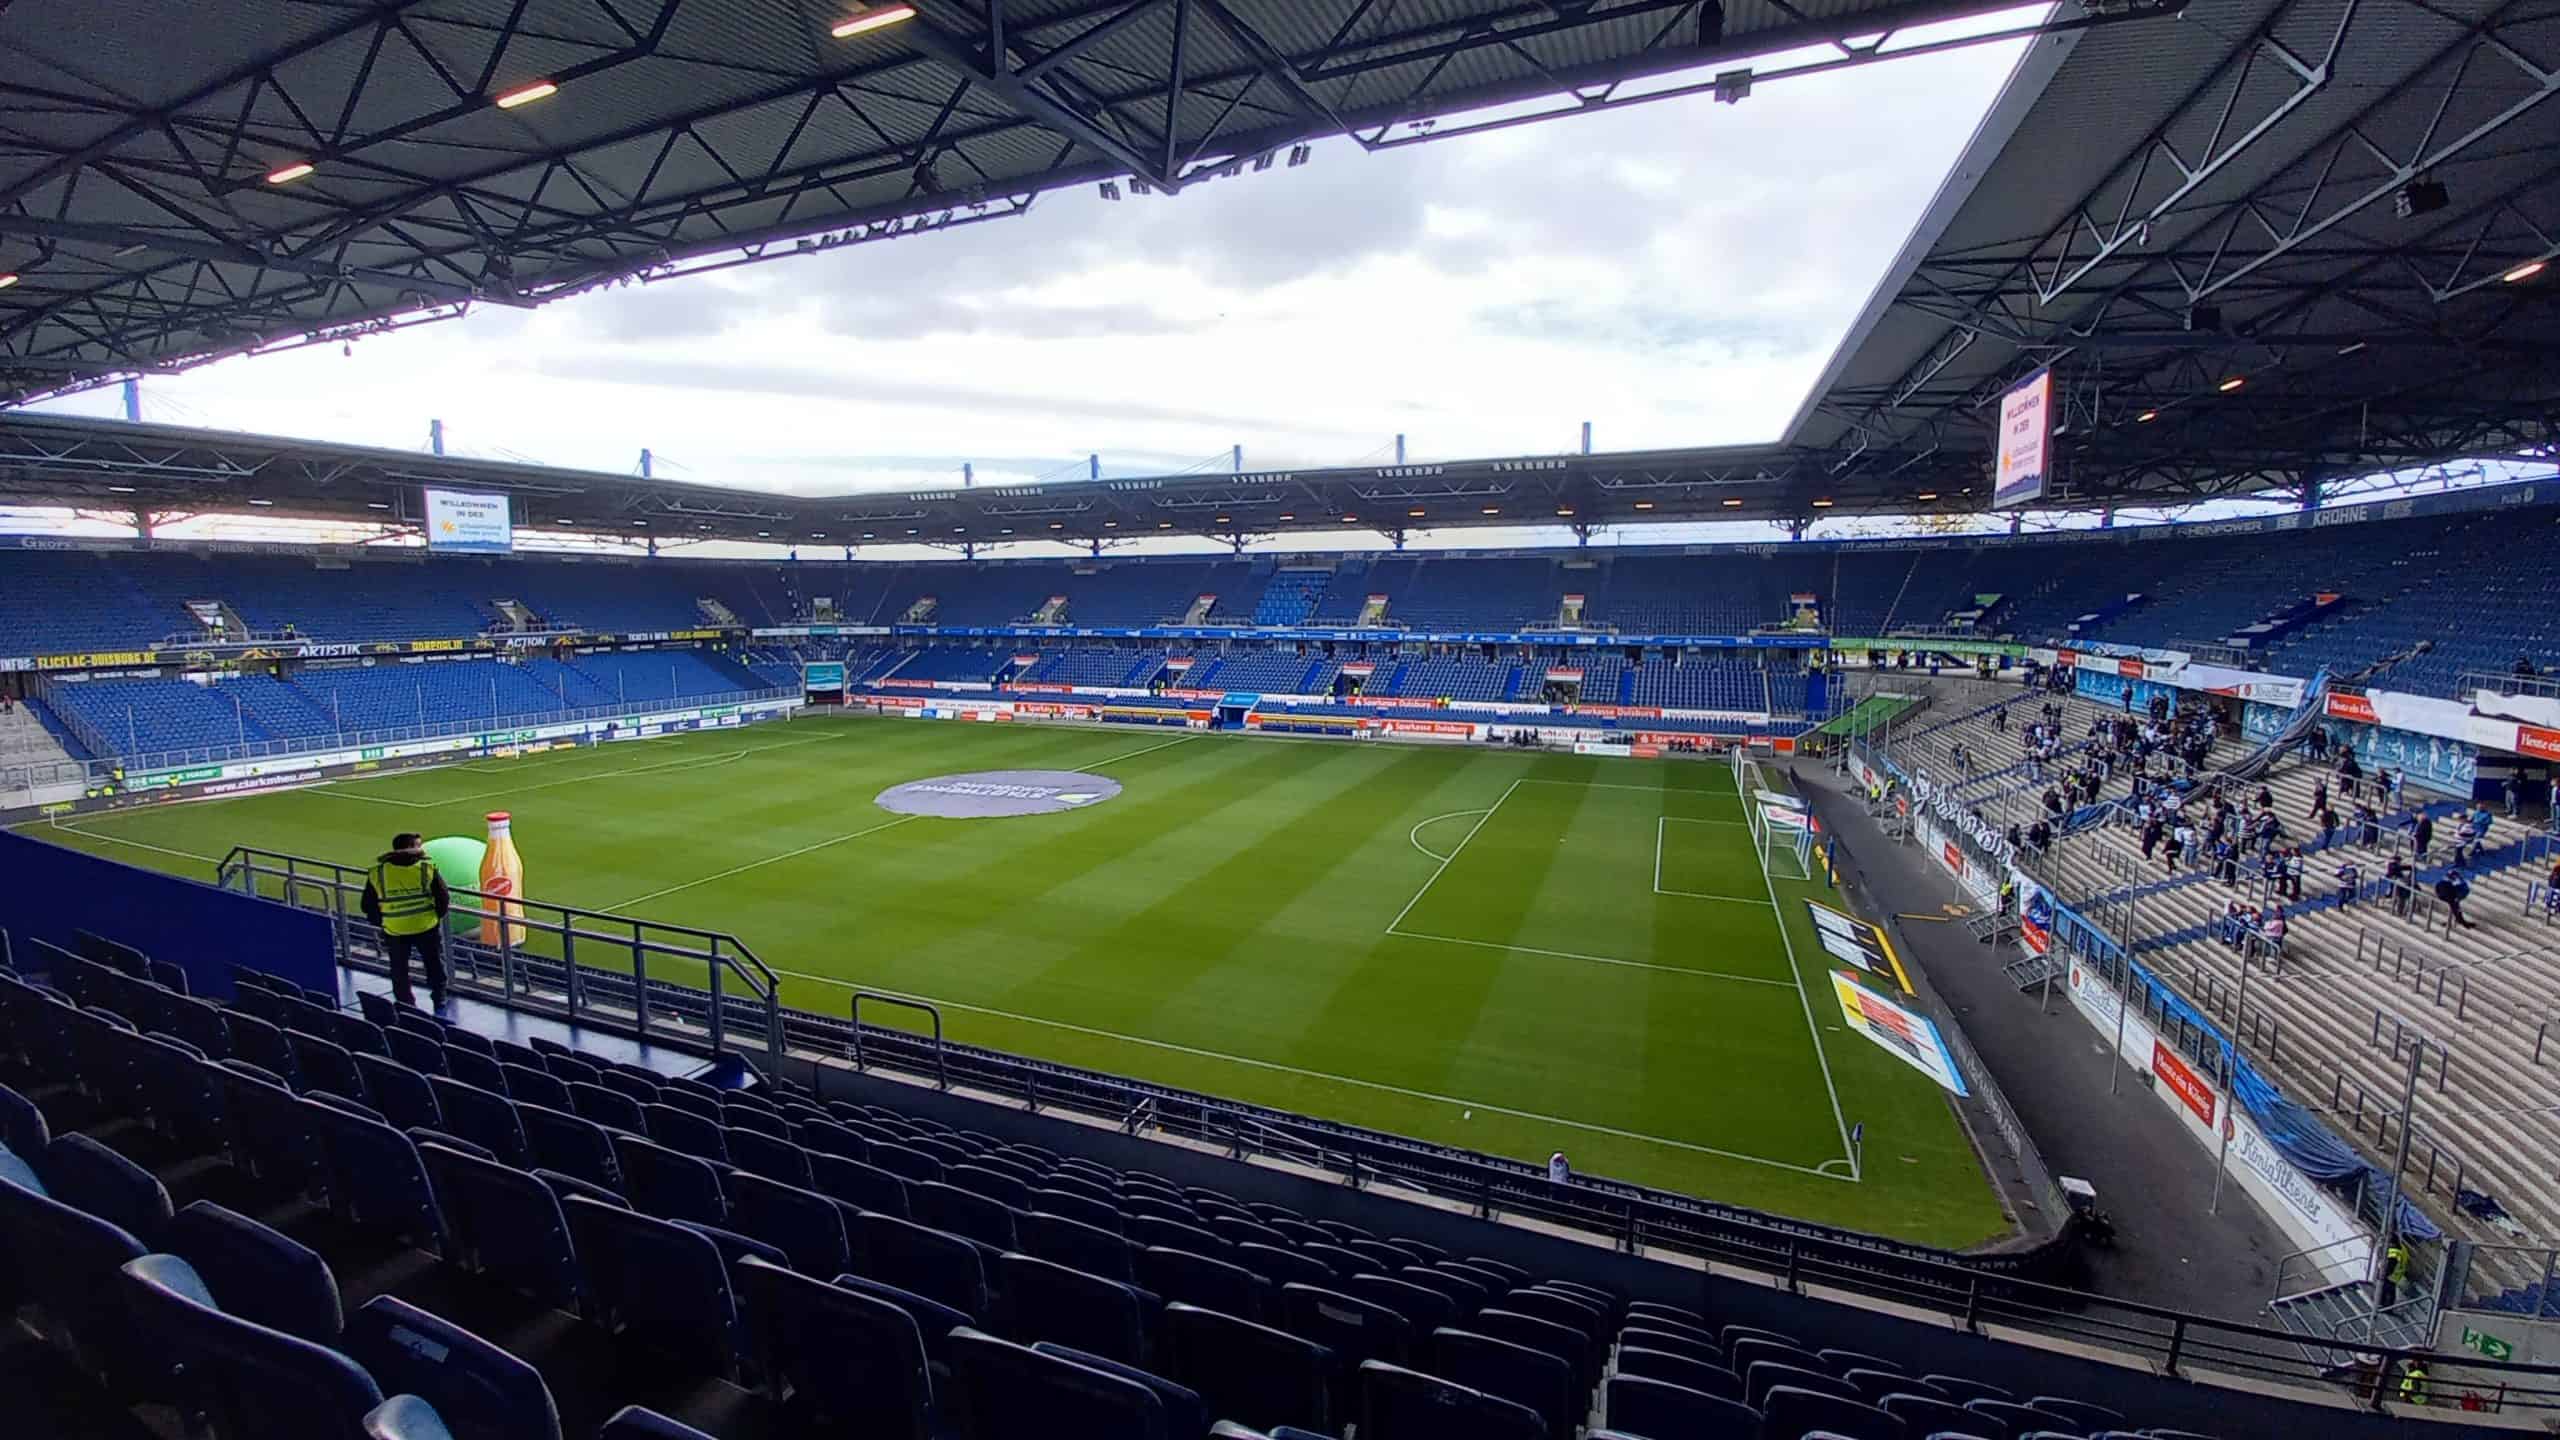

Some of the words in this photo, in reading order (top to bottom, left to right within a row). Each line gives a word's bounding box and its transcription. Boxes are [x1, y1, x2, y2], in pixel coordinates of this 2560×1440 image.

[2313, 505, 2368, 527] KROHNE
[297, 644, 360, 658] ARTISTIK
[2521, 732, 2548, 750] Heute
